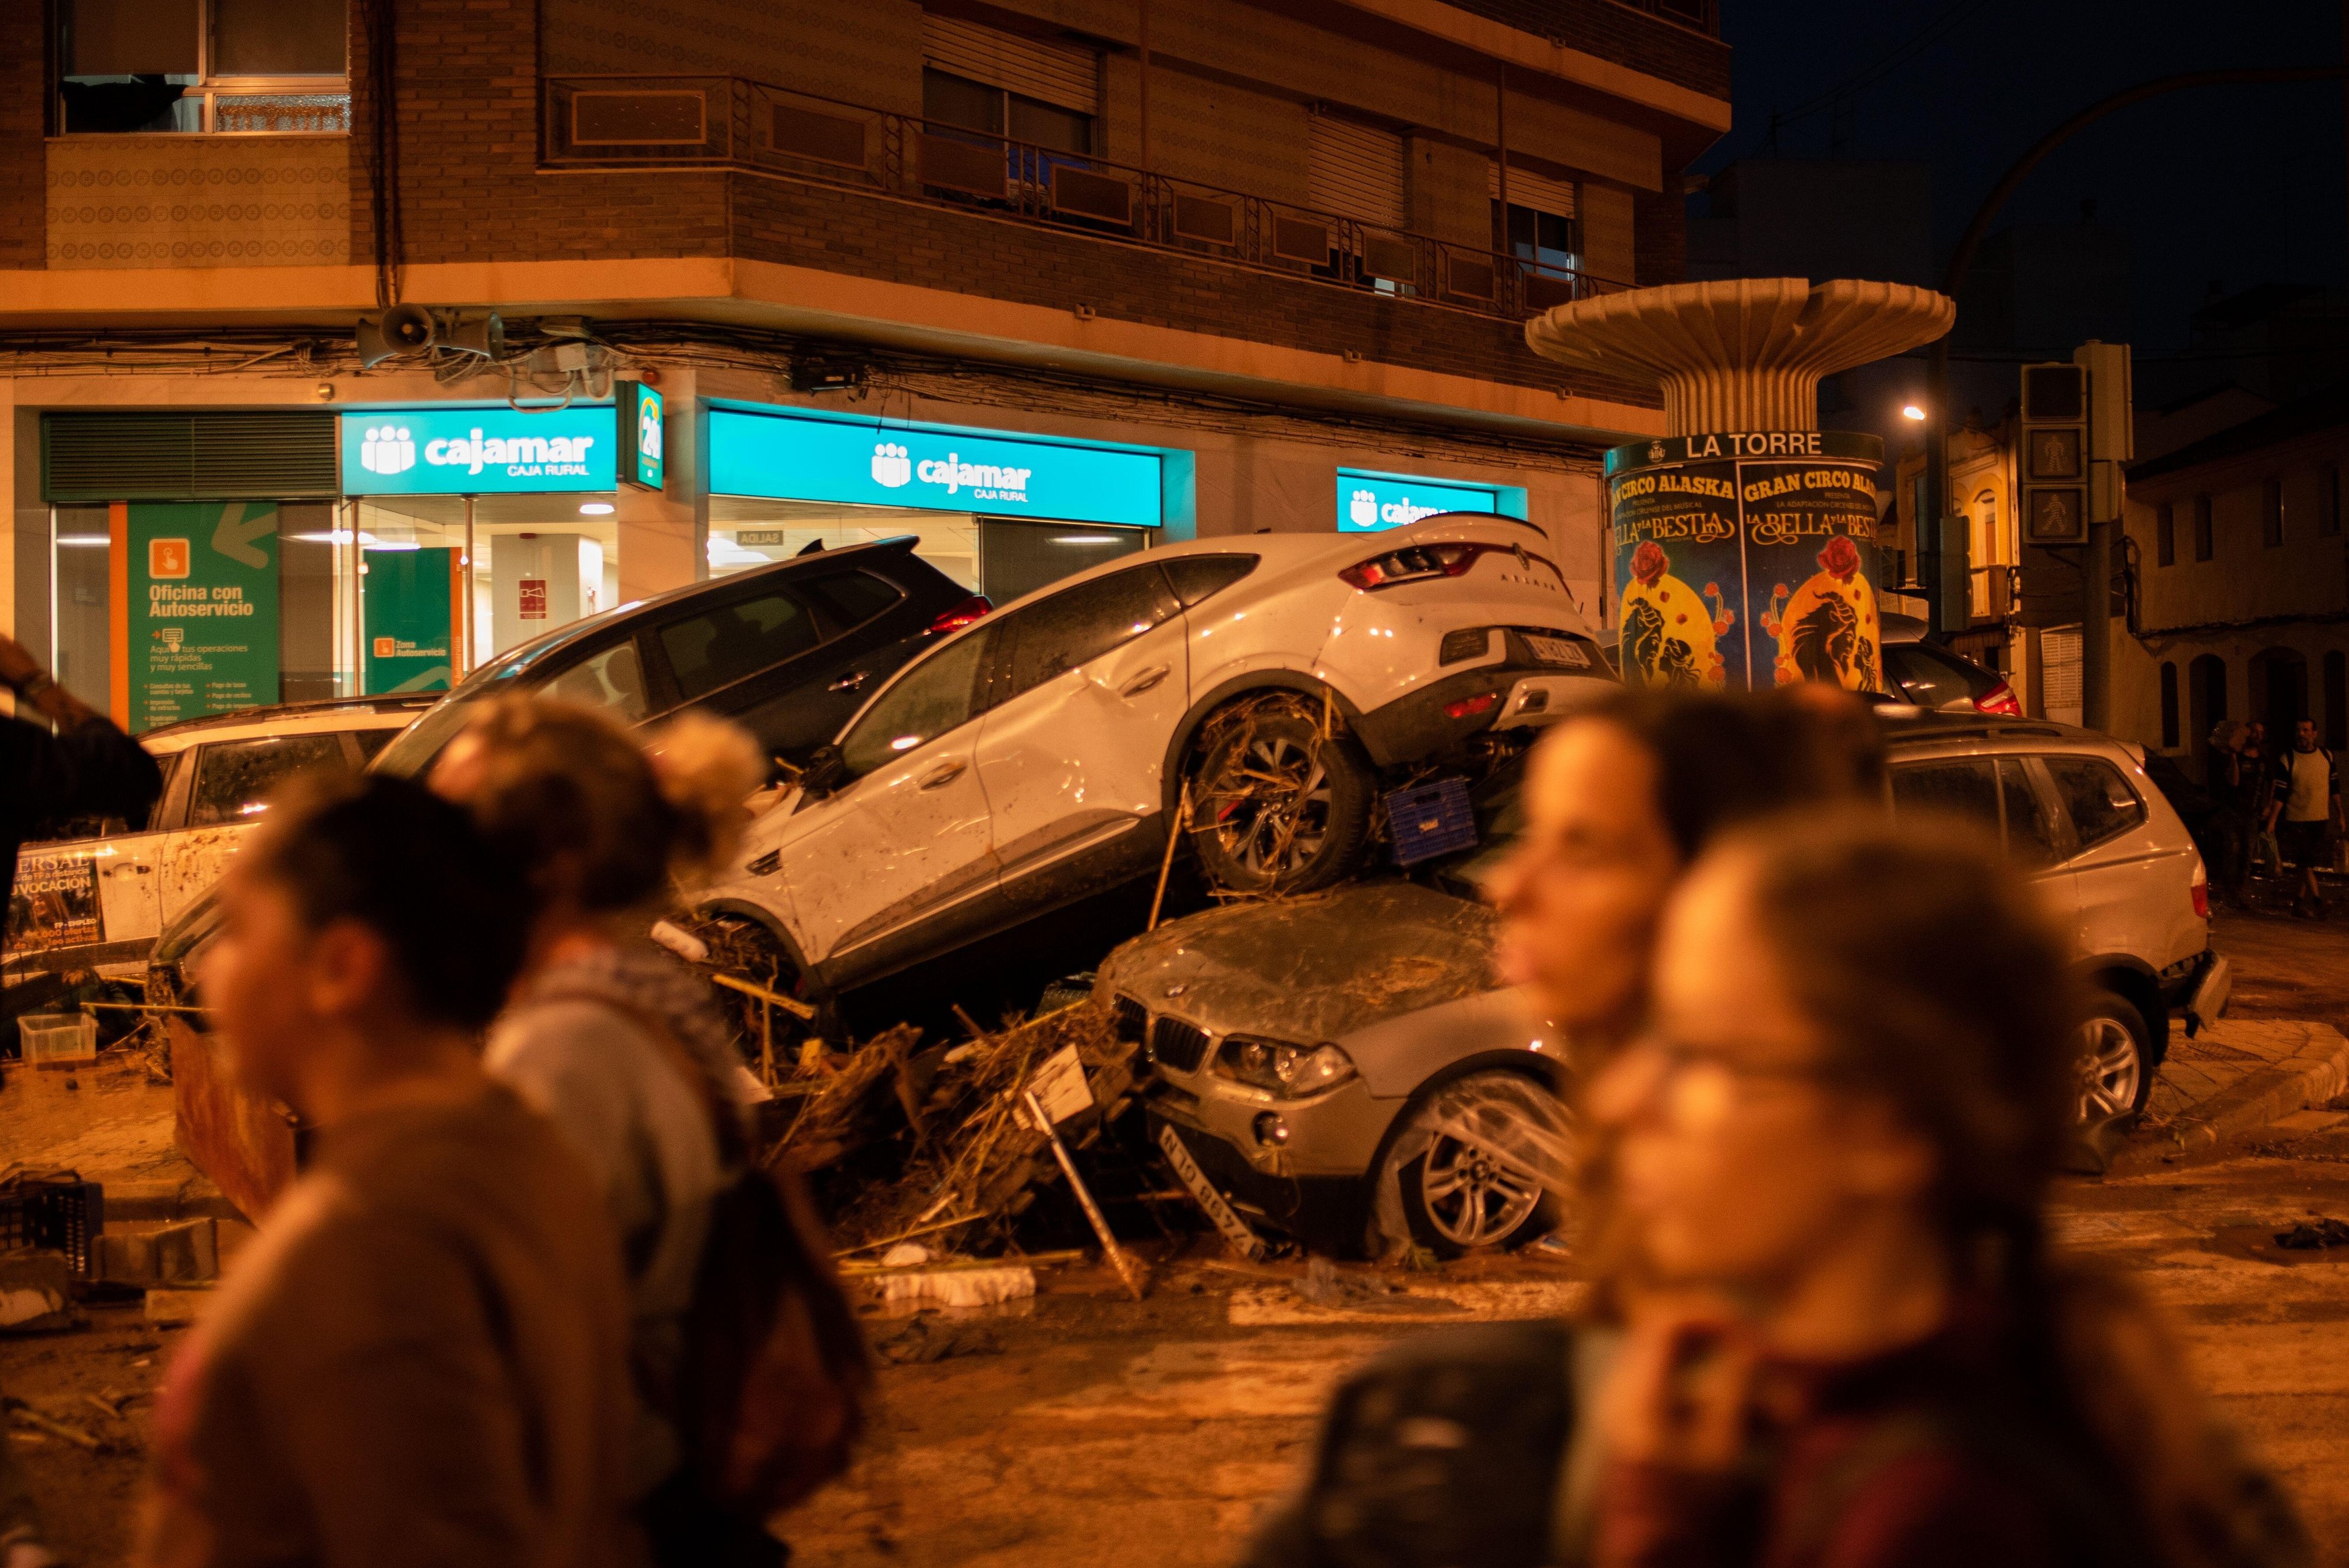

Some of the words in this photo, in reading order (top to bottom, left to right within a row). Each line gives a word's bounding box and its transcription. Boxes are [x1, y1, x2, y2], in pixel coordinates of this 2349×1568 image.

[425, 427, 594, 476] cajamar
[1687, 435, 1721, 458] LA
[1729, 433, 1822, 455] TORRE
[507, 465, 542, 476] CAJA
[545, 464, 589, 476] RURAL
[917, 453, 1031, 494] cajamar
[1622, 476, 1655, 500] CIRCO
[1658, 475, 1735, 500] ALASKA
[1744, 474, 1800, 502] GRAN
[1804, 471, 1851, 488] CIRCO
[974, 488, 997, 500] CAJA
[999, 491, 1029, 502] RURAL
[1746, 514, 1761, 524] LA
[1652, 512, 1735, 543] BESTIA
[1752, 514, 1834, 545] BELLA
[149, 585, 207, 601] Oficina
[212, 587, 242, 600] con
[149, 601, 253, 616] Autoservicio
[197, 645, 248, 654] operaciones
[396, 640, 416, 648] Zona
[171, 654, 202, 662] rápidas
[396, 648, 446, 656] Autoservicio
[150, 664, 155, 672] y
[177, 662, 213, 670] sencillas
[52, 867, 90, 877] distancia
[19, 875, 92, 895] VOCACIÓN
[68, 919, 96, 928] EMPLEO
